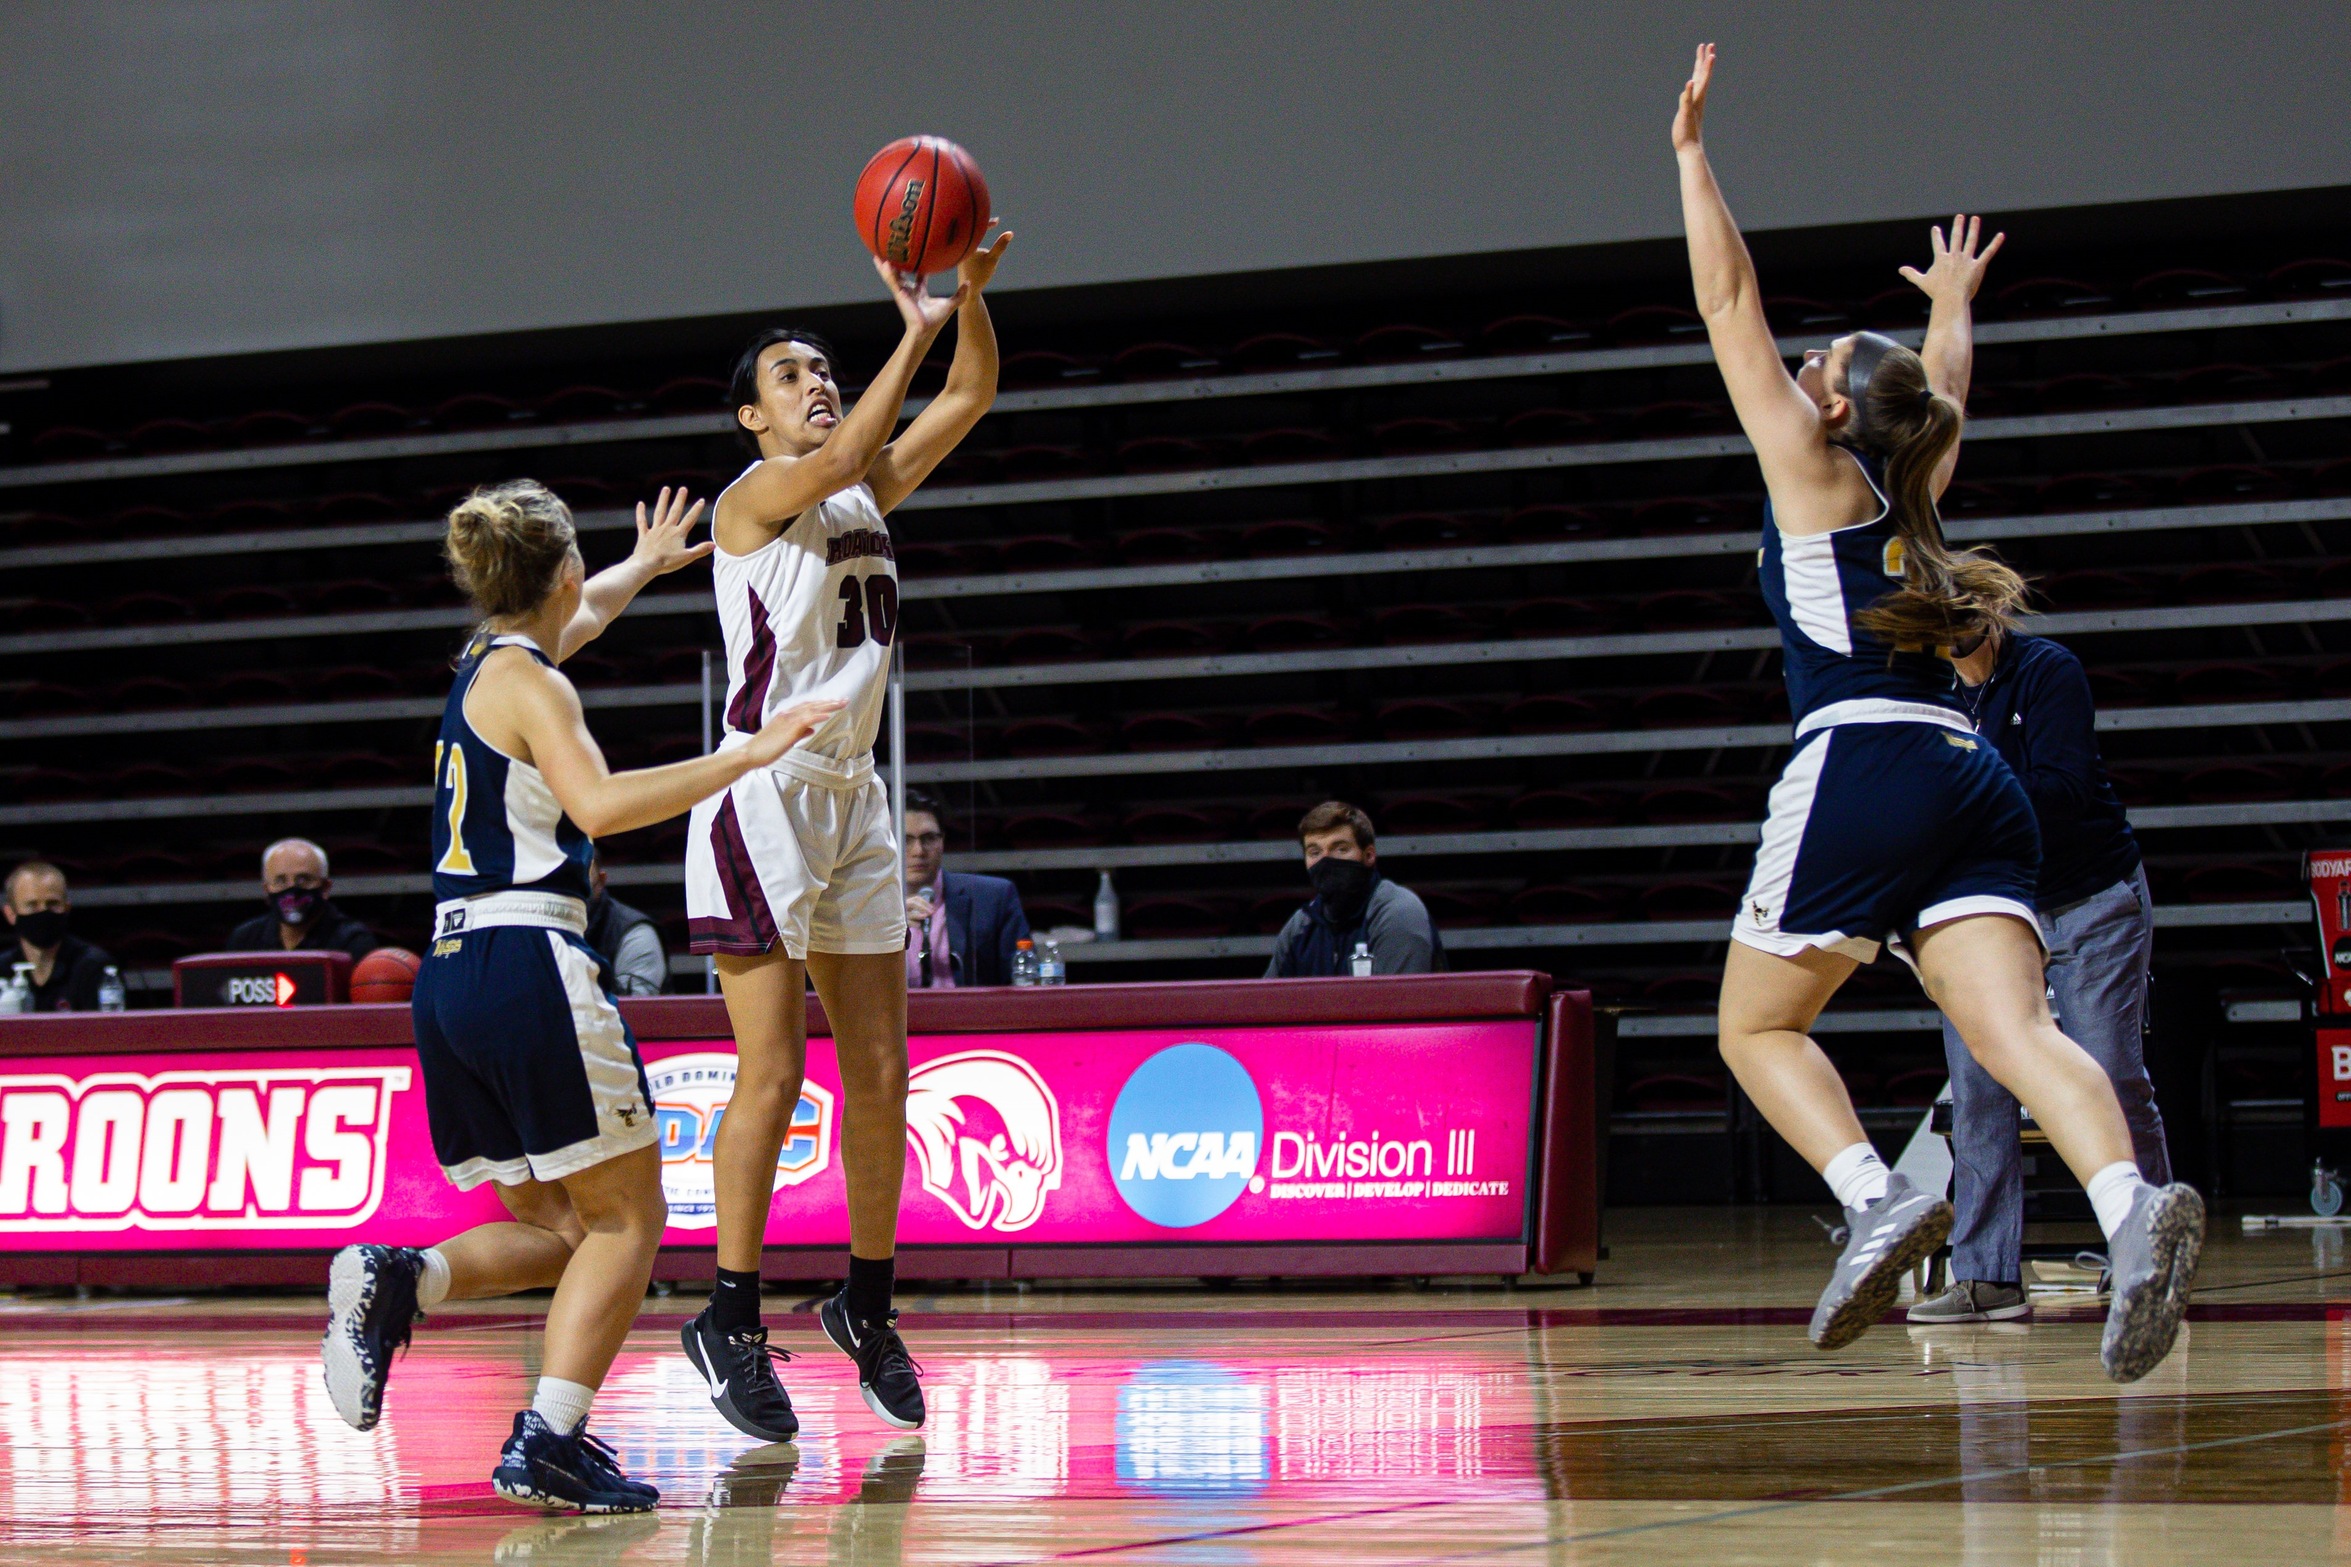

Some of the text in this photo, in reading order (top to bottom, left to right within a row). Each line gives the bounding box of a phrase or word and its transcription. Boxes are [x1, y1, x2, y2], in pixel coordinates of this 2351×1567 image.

[837, 574, 898, 649] 30
[229, 977, 276, 1003] POSS
[649, 1075, 674, 1094] LD
[0, 1084, 379, 1215] ROONS
[1120, 1131, 1255, 1180] NCAA
[1271, 1129, 1475, 1178] Division III
[1270, 1181, 1509, 1199] DISCOVER DEVELOP DEDICATE
